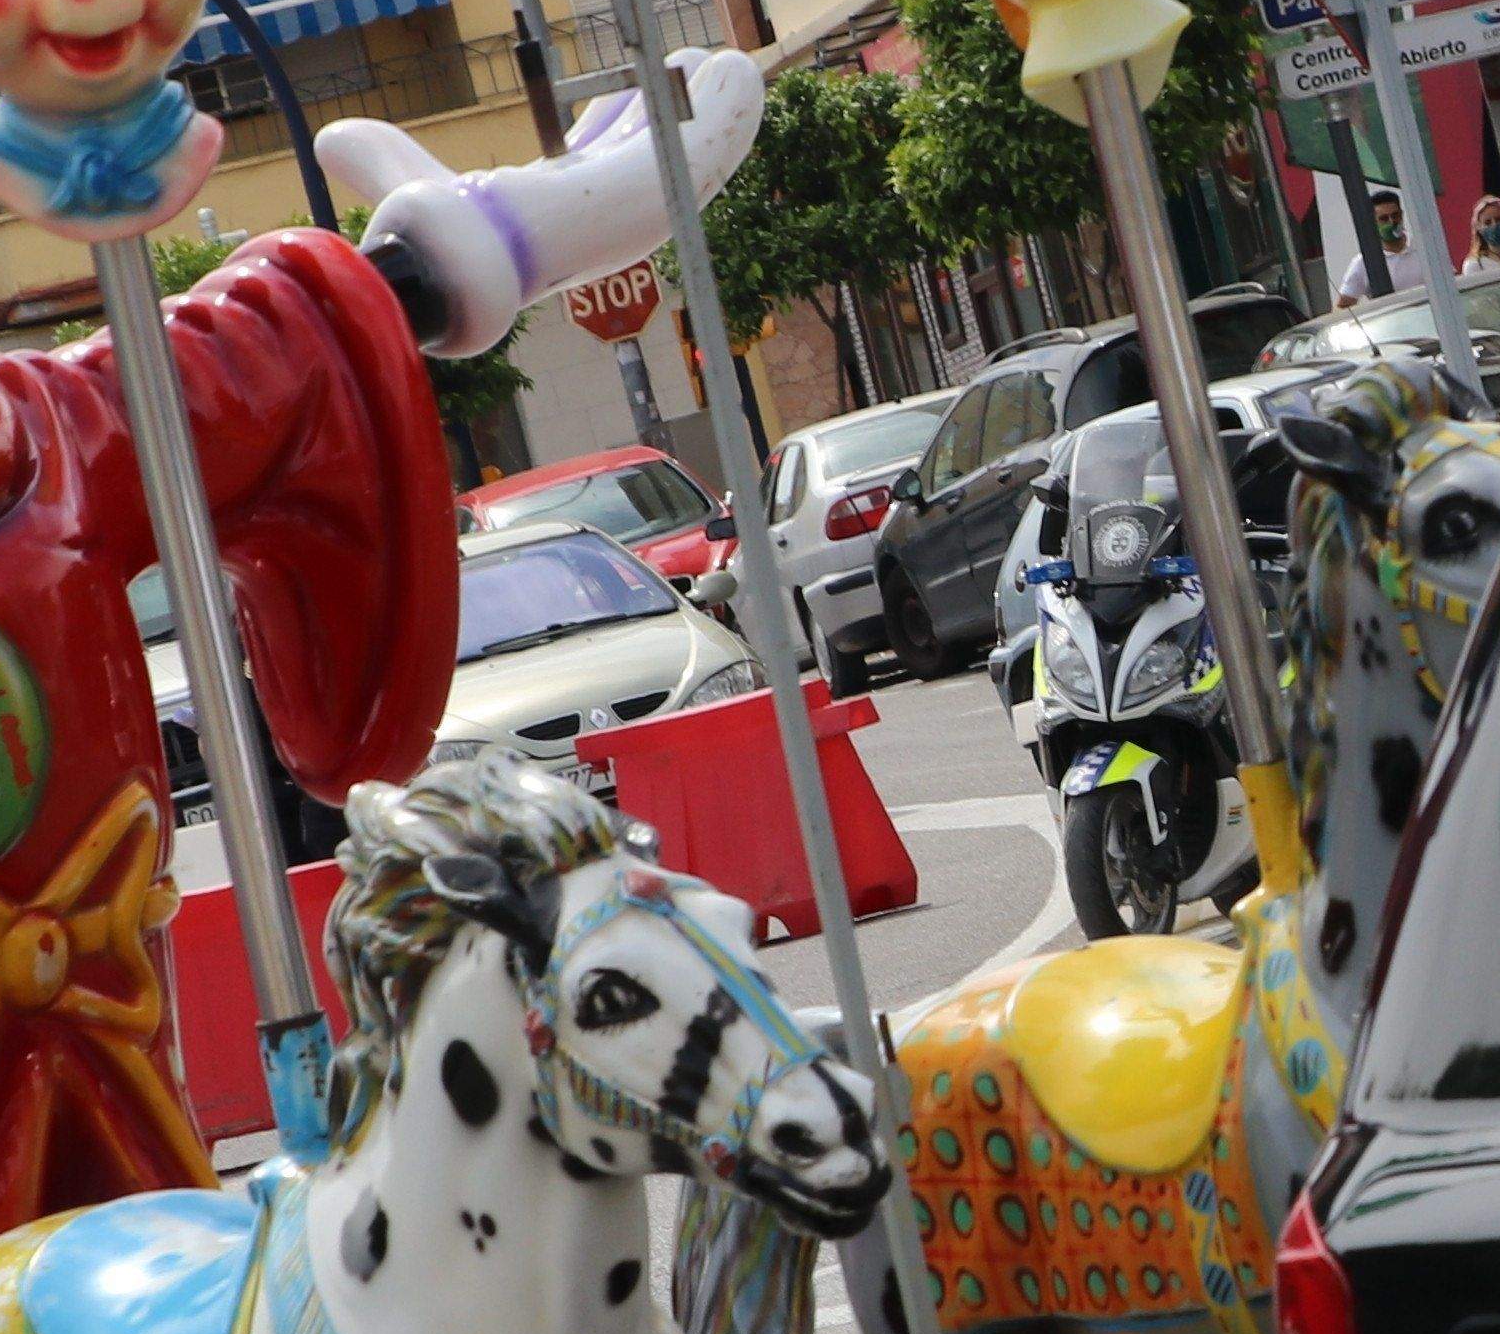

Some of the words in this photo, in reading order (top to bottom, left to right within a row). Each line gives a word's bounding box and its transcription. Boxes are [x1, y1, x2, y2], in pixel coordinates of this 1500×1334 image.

[1291, 45, 1353, 69] Centro
[1400, 39, 1467, 66] Abierto
[567, 268, 652, 318] STOP
